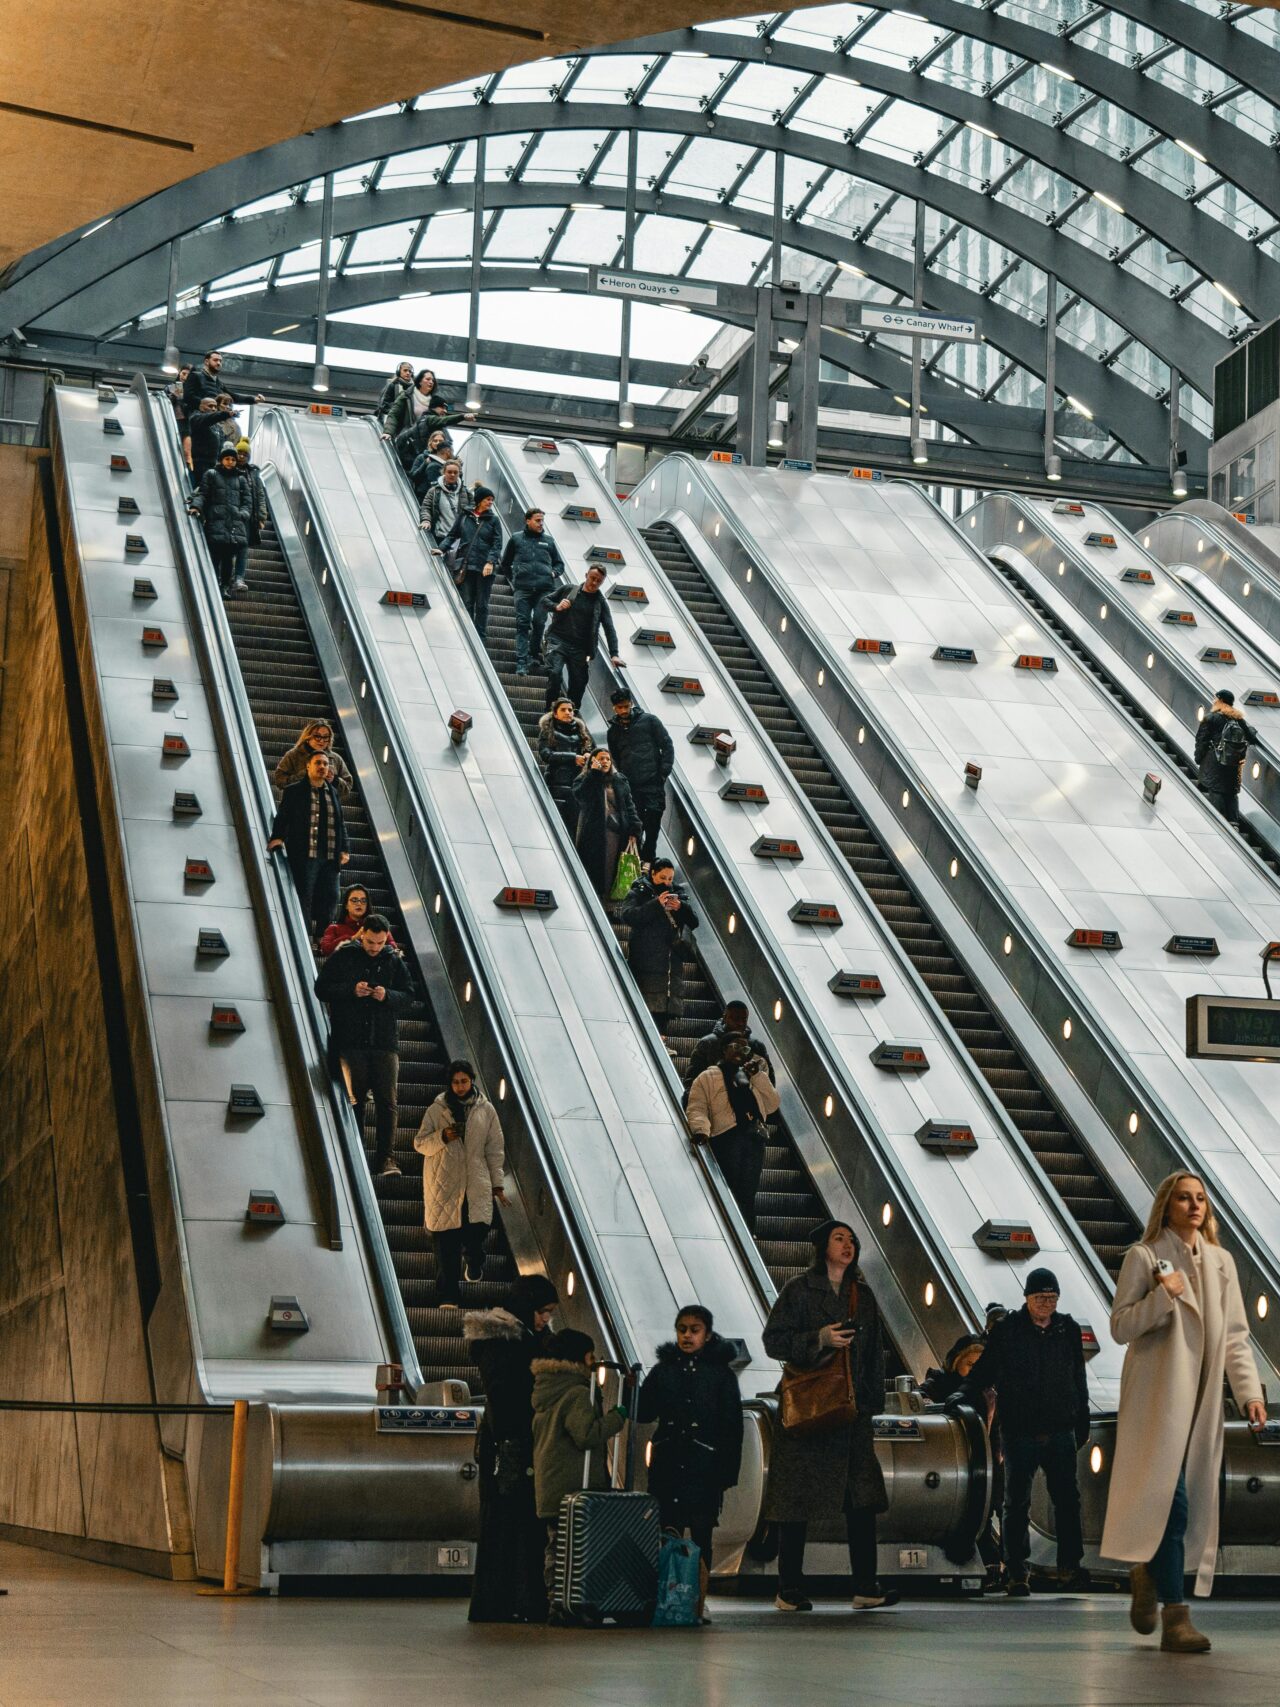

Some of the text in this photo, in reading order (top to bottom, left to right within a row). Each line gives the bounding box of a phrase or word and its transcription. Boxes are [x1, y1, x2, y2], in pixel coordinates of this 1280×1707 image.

[609, 278, 667, 294] Heron Quays
[906, 318, 963, 332] Canary Wharf
[1232, 1012, 1273, 1034] Way
[446, 1549, 461, 1563] 10
[907, 1551, 919, 1564] 11
